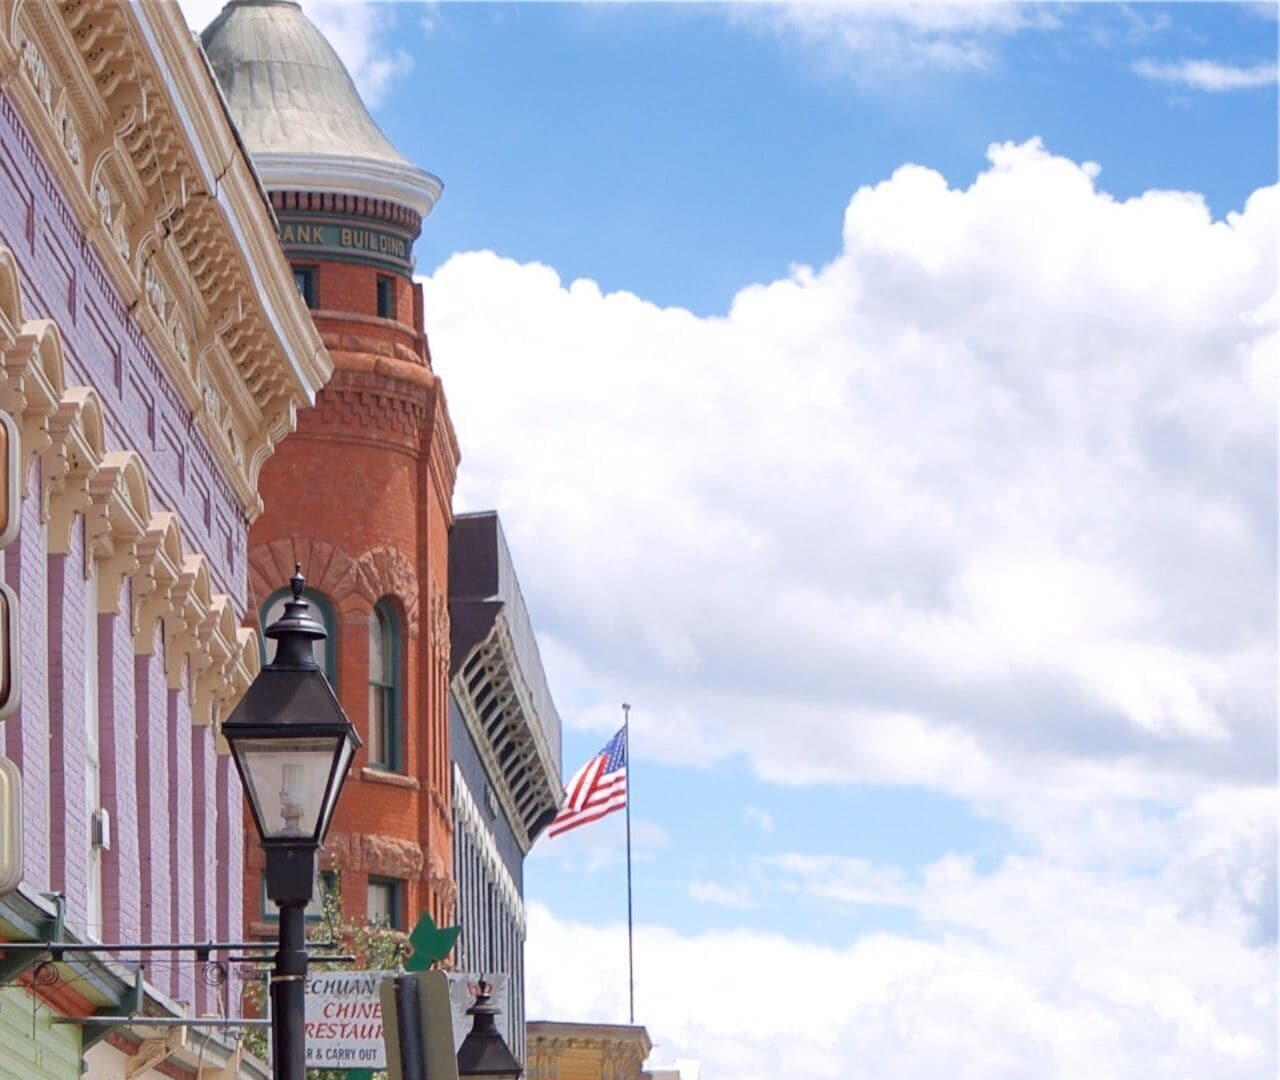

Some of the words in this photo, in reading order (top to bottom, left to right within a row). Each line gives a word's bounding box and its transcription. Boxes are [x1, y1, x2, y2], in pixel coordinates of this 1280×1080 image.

[281, 225, 325, 244] ANK
[340, 228, 406, 258] BUILDING
[305, 979, 377, 995] ECHUAN
[323, 1002, 383, 1019] CHINE
[304, 1023, 384, 1039] RESTAUR
[326, 1047, 356, 1060] CARRY
[359, 1047, 378, 1061] OUT
